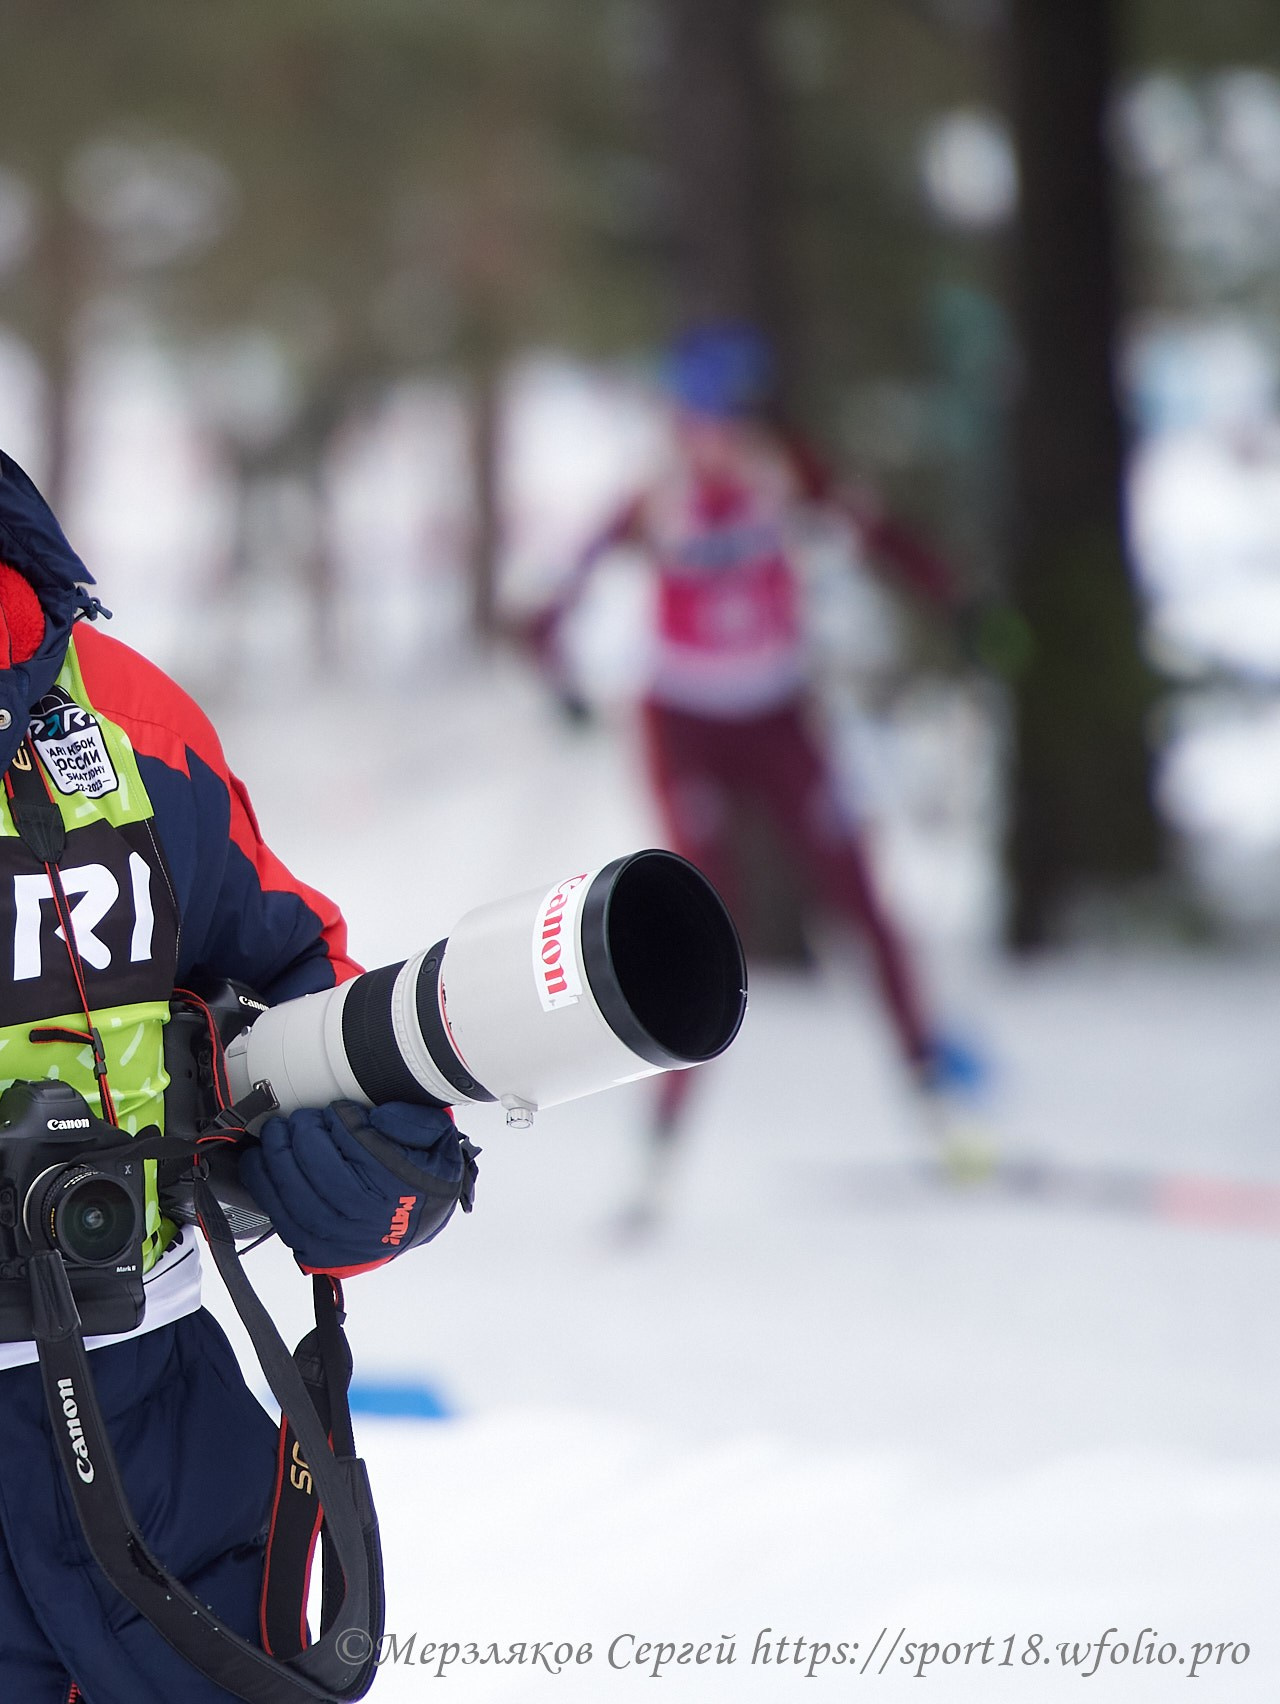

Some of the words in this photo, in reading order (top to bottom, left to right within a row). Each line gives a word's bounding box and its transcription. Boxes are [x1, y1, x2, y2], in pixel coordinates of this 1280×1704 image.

[542, 873, 588, 995] Canon
[46, 1118, 90, 1131] Canon
[57, 1378, 95, 1484] Canon
